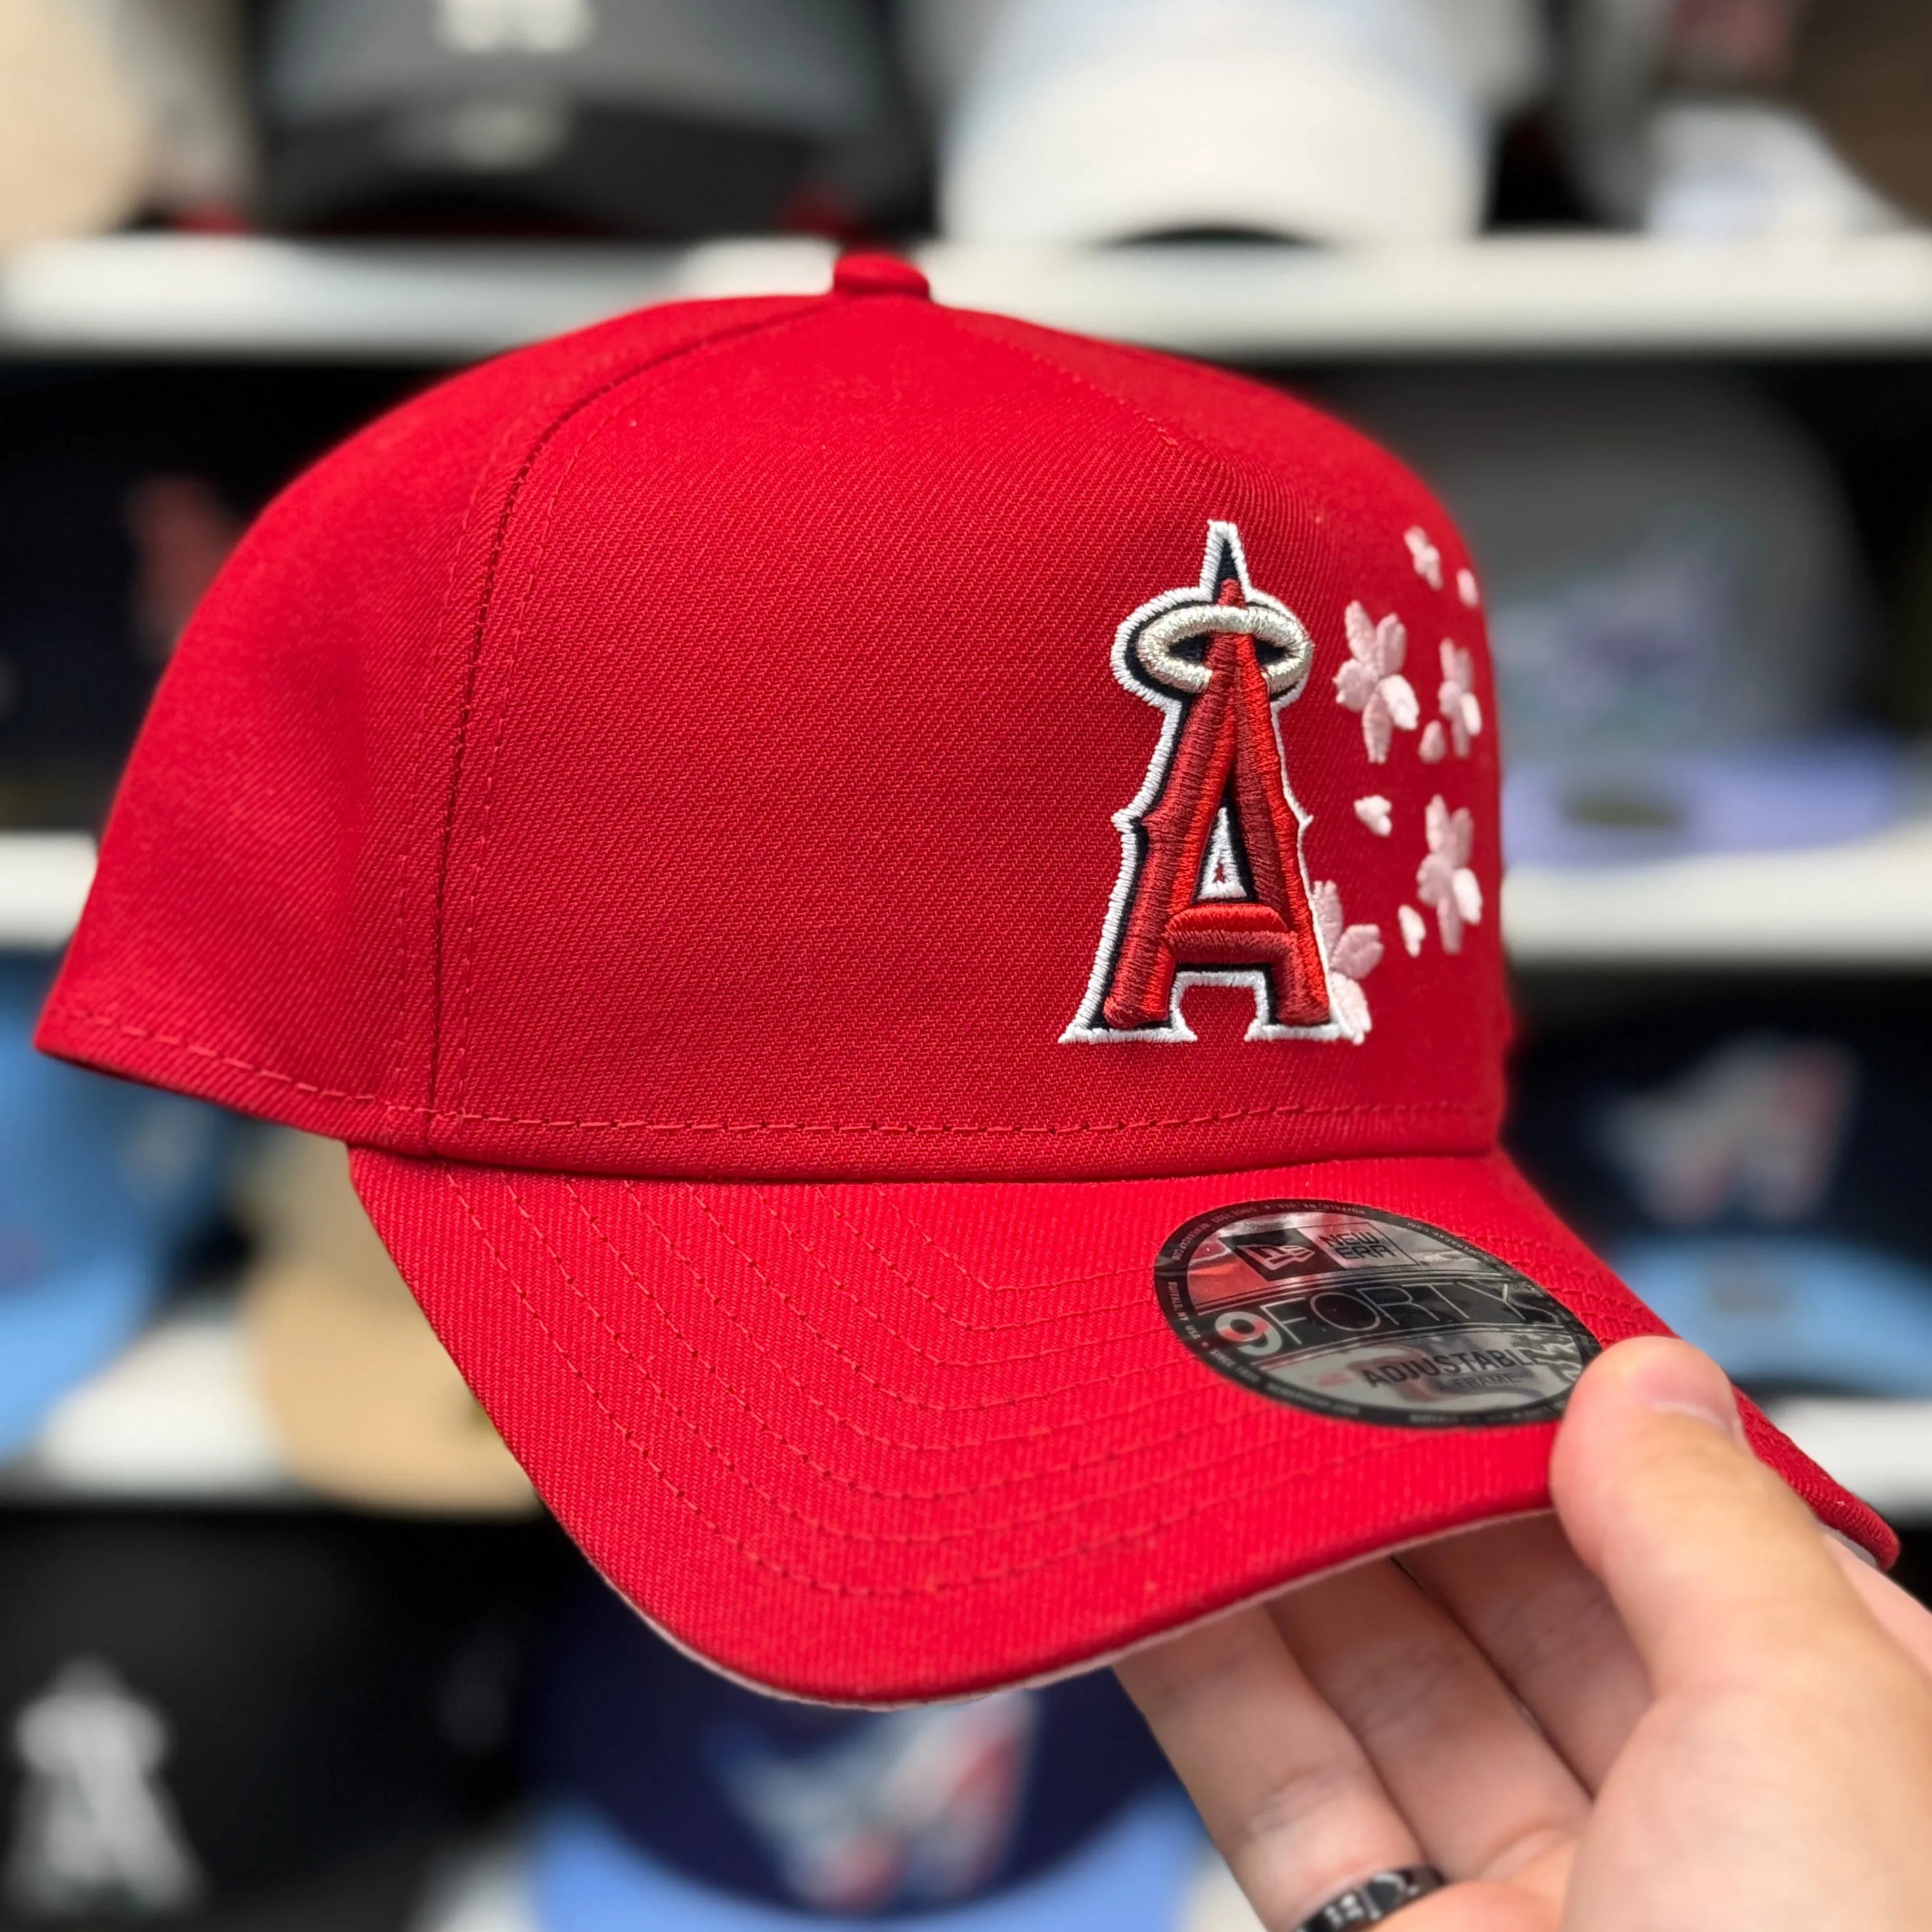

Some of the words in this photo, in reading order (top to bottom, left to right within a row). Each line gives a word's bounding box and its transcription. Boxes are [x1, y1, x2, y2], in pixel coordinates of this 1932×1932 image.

[1058, 520, 1361, 1043] A
[1318, 1232, 1380, 1248] NEW
[1336, 1245, 1397, 1259] ERA
[1215, 1283, 1526, 1356] 9FORTY
[1185, 1324, 1201, 1339] USA
[1209, 1349, 1236, 1367] SINCE
[1361, 1349, 1542, 1387] ADJUSTABLE
